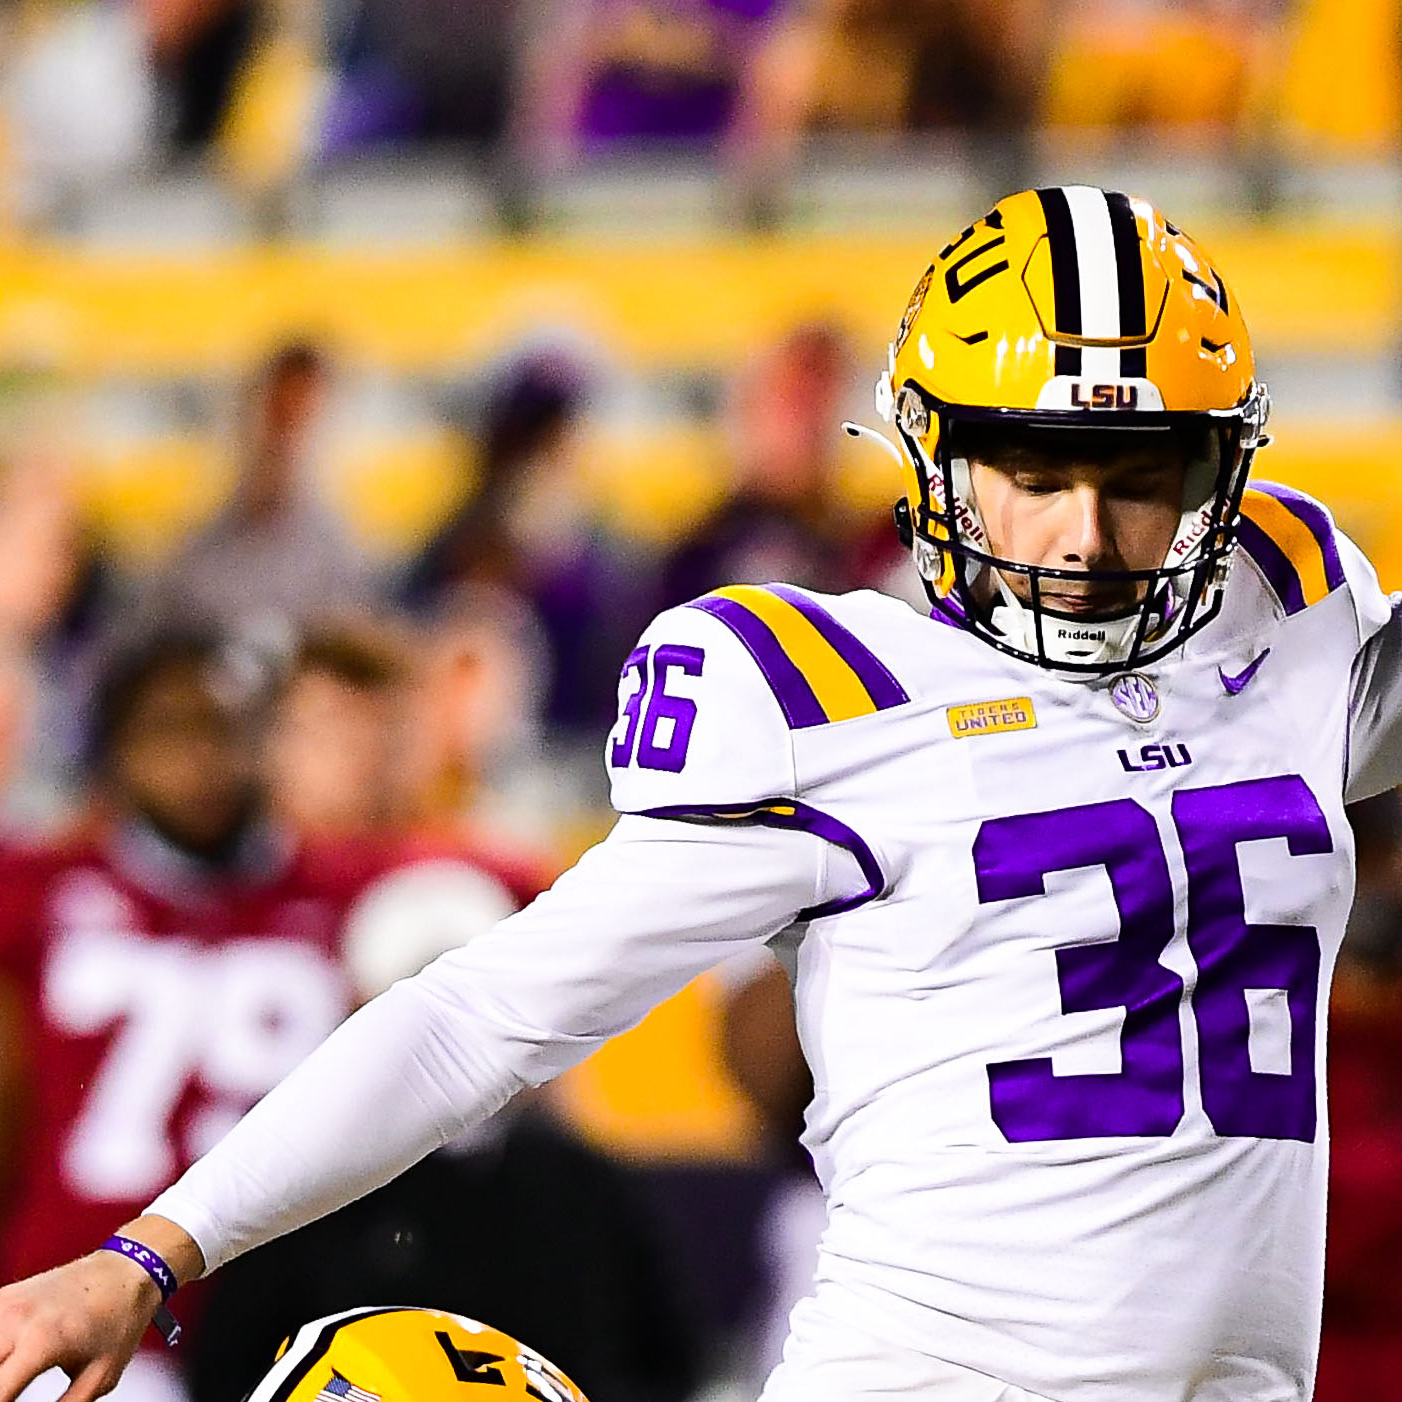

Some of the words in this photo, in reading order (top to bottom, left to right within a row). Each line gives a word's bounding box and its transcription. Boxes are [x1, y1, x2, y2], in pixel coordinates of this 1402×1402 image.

[1070, 383, 1138, 408] LSU
[1057, 629, 1106, 641] Riddell
[612, 644, 706, 773] 36
[955, 711, 1028, 732] UNITED
[1116, 743, 1193, 773] LSU
[972, 774, 1334, 1144] 36
